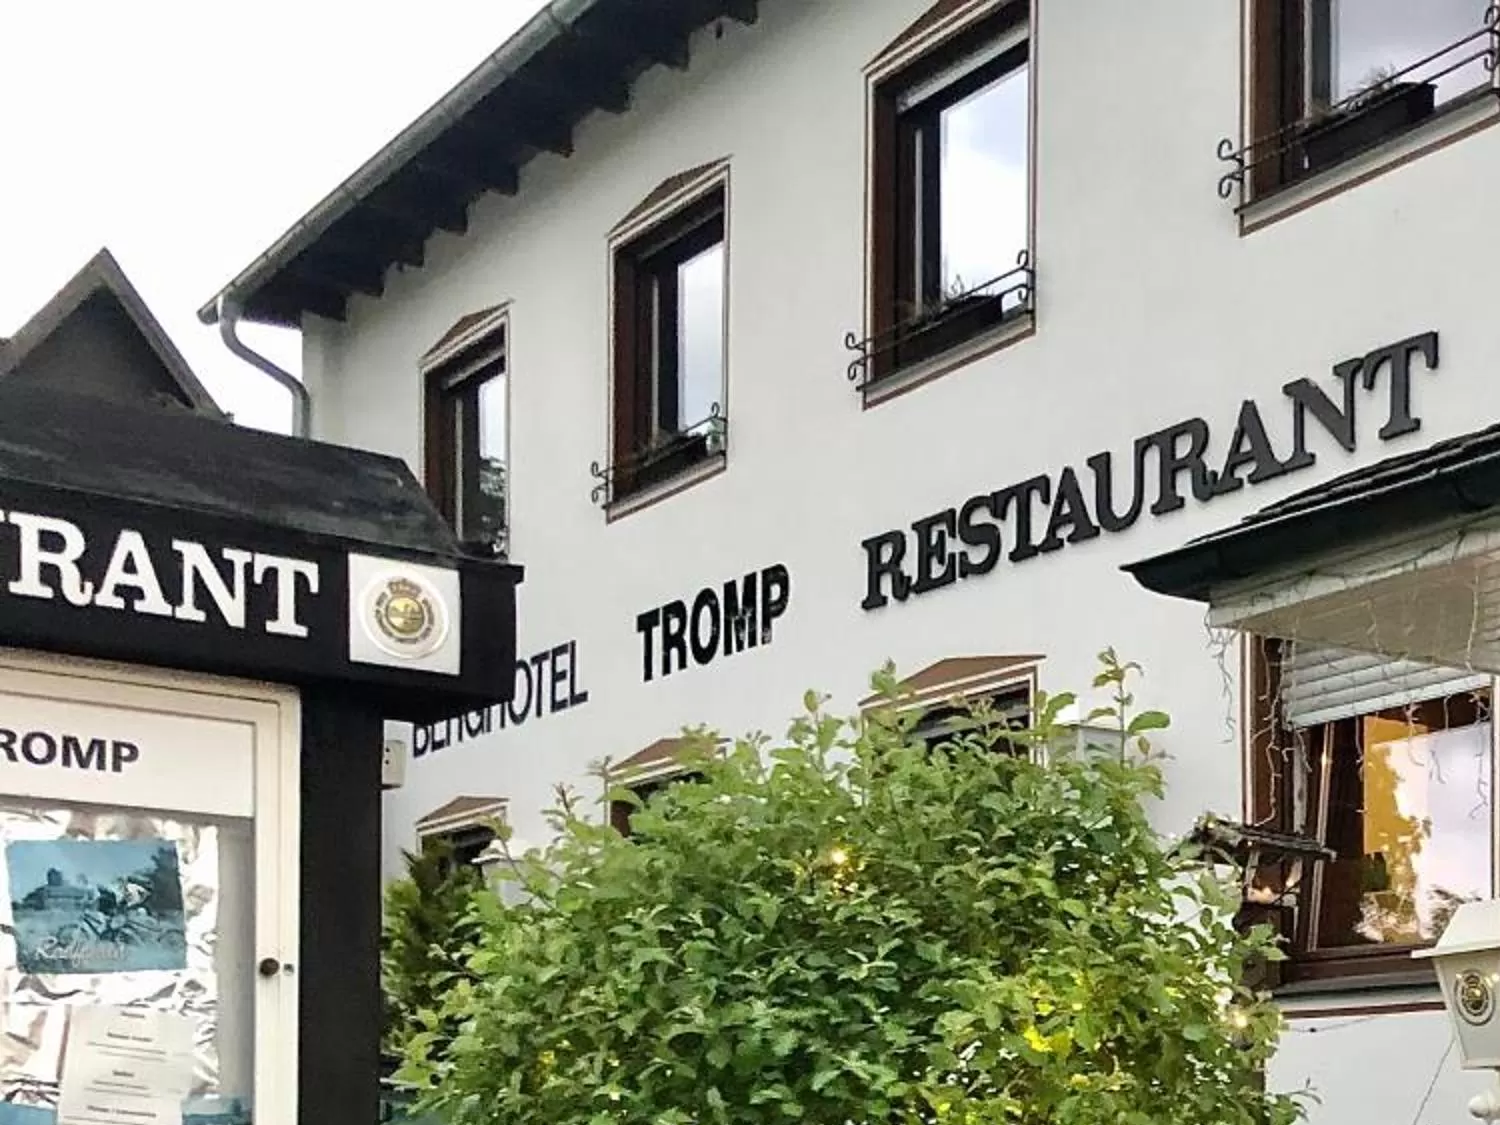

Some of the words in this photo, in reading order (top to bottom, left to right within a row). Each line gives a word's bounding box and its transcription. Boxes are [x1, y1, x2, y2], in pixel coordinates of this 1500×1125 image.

[0, 509, 319, 637] RANT
[638, 562, 791, 683] TROMP
[861, 331, 1439, 612] RESTAURANT
